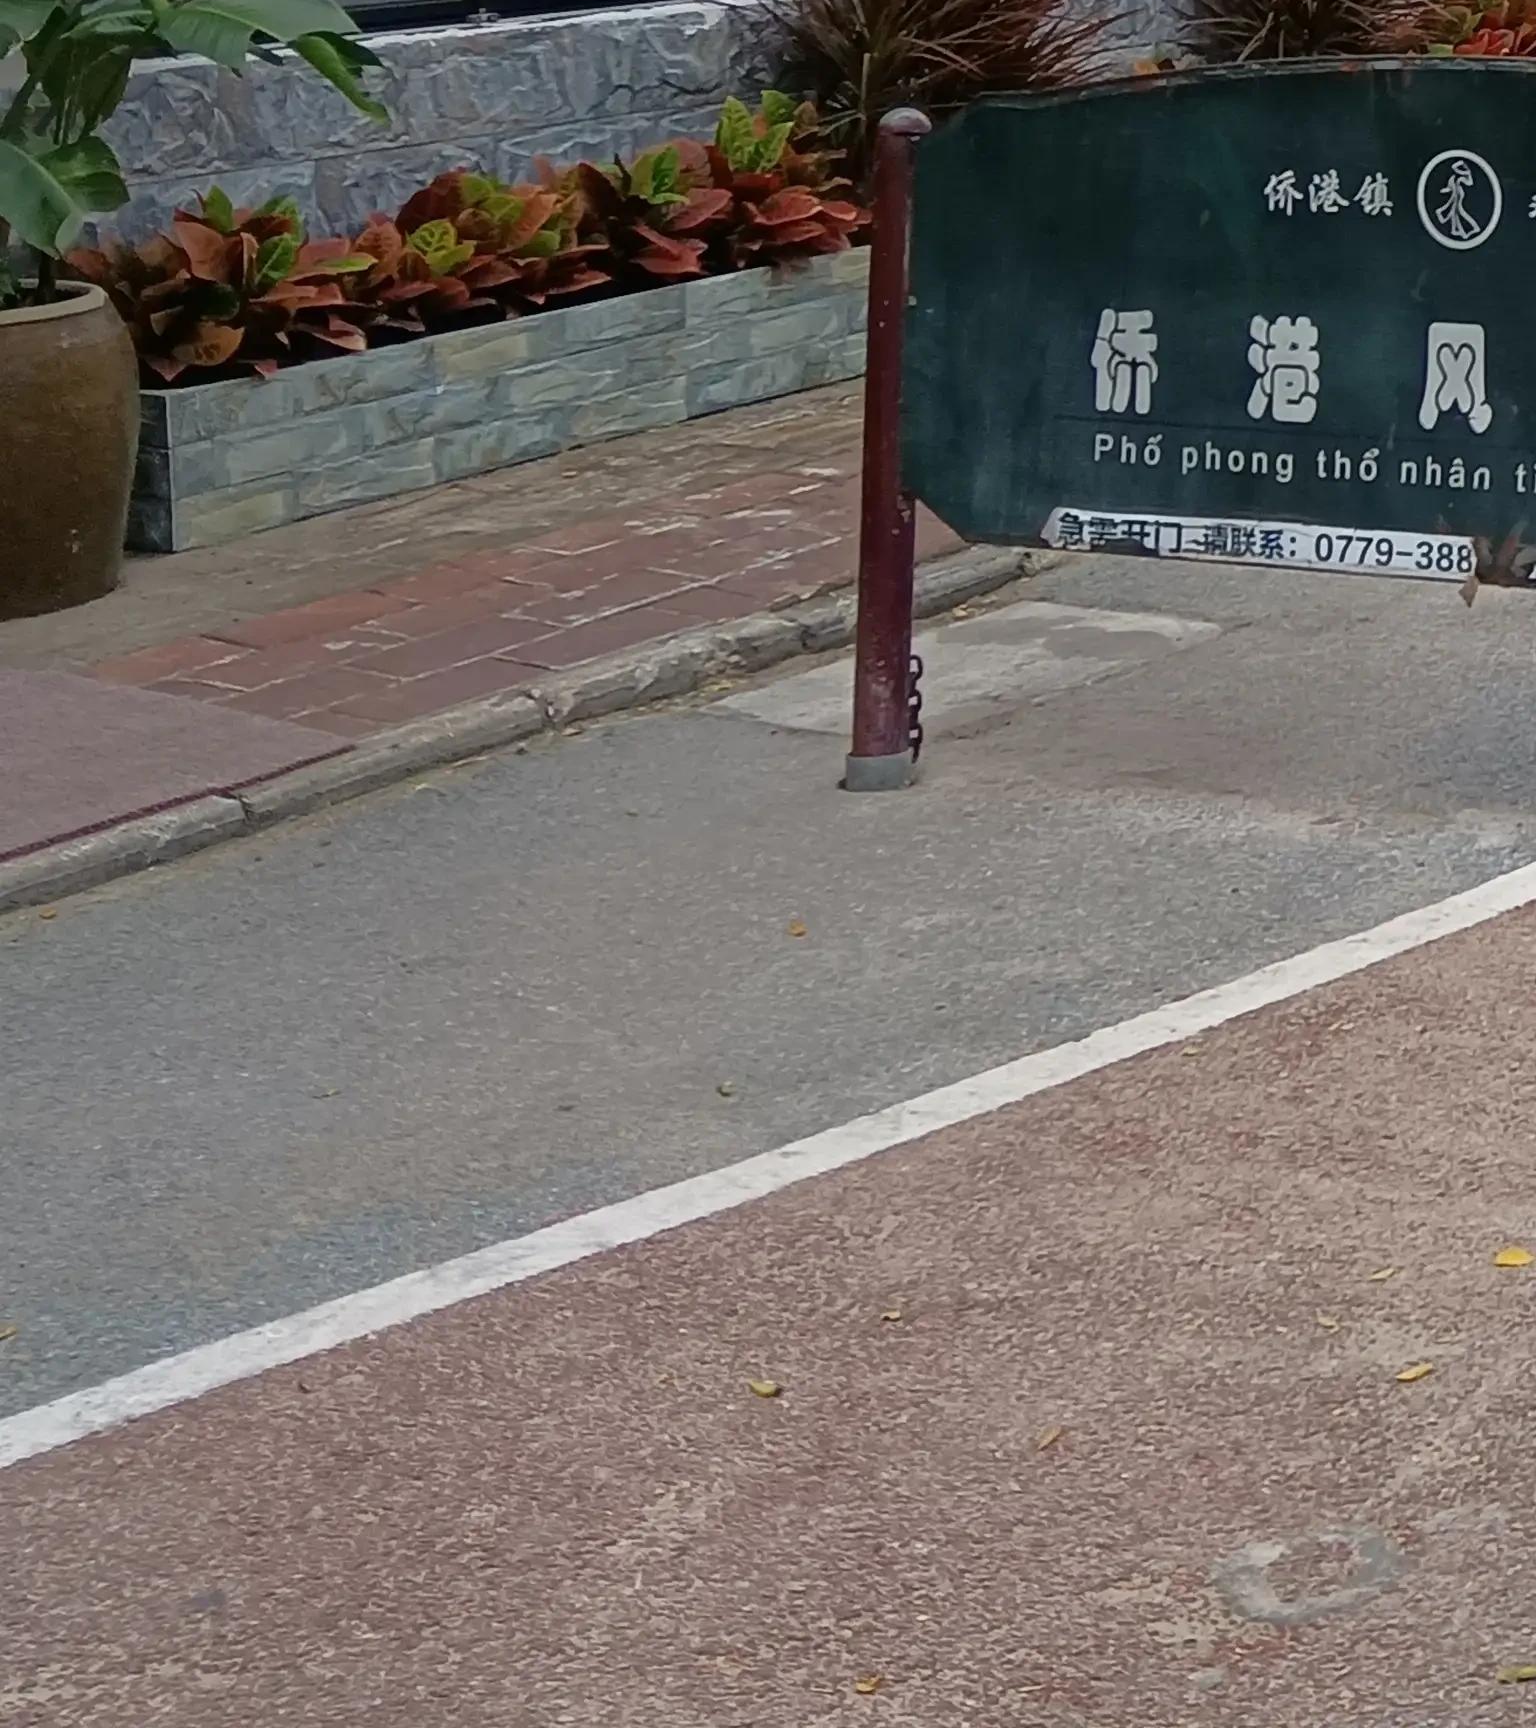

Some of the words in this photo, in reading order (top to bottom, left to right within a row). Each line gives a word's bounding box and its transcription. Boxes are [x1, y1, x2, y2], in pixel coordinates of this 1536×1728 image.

[1262, 168, 1394, 218] 侨港镇
[1093, 434, 1162, 468] Phố
[1180, 445, 1296, 483] phong
[1315, 439, 1379, 483] thổ
[1399, 454, 1492, 492] nhân
